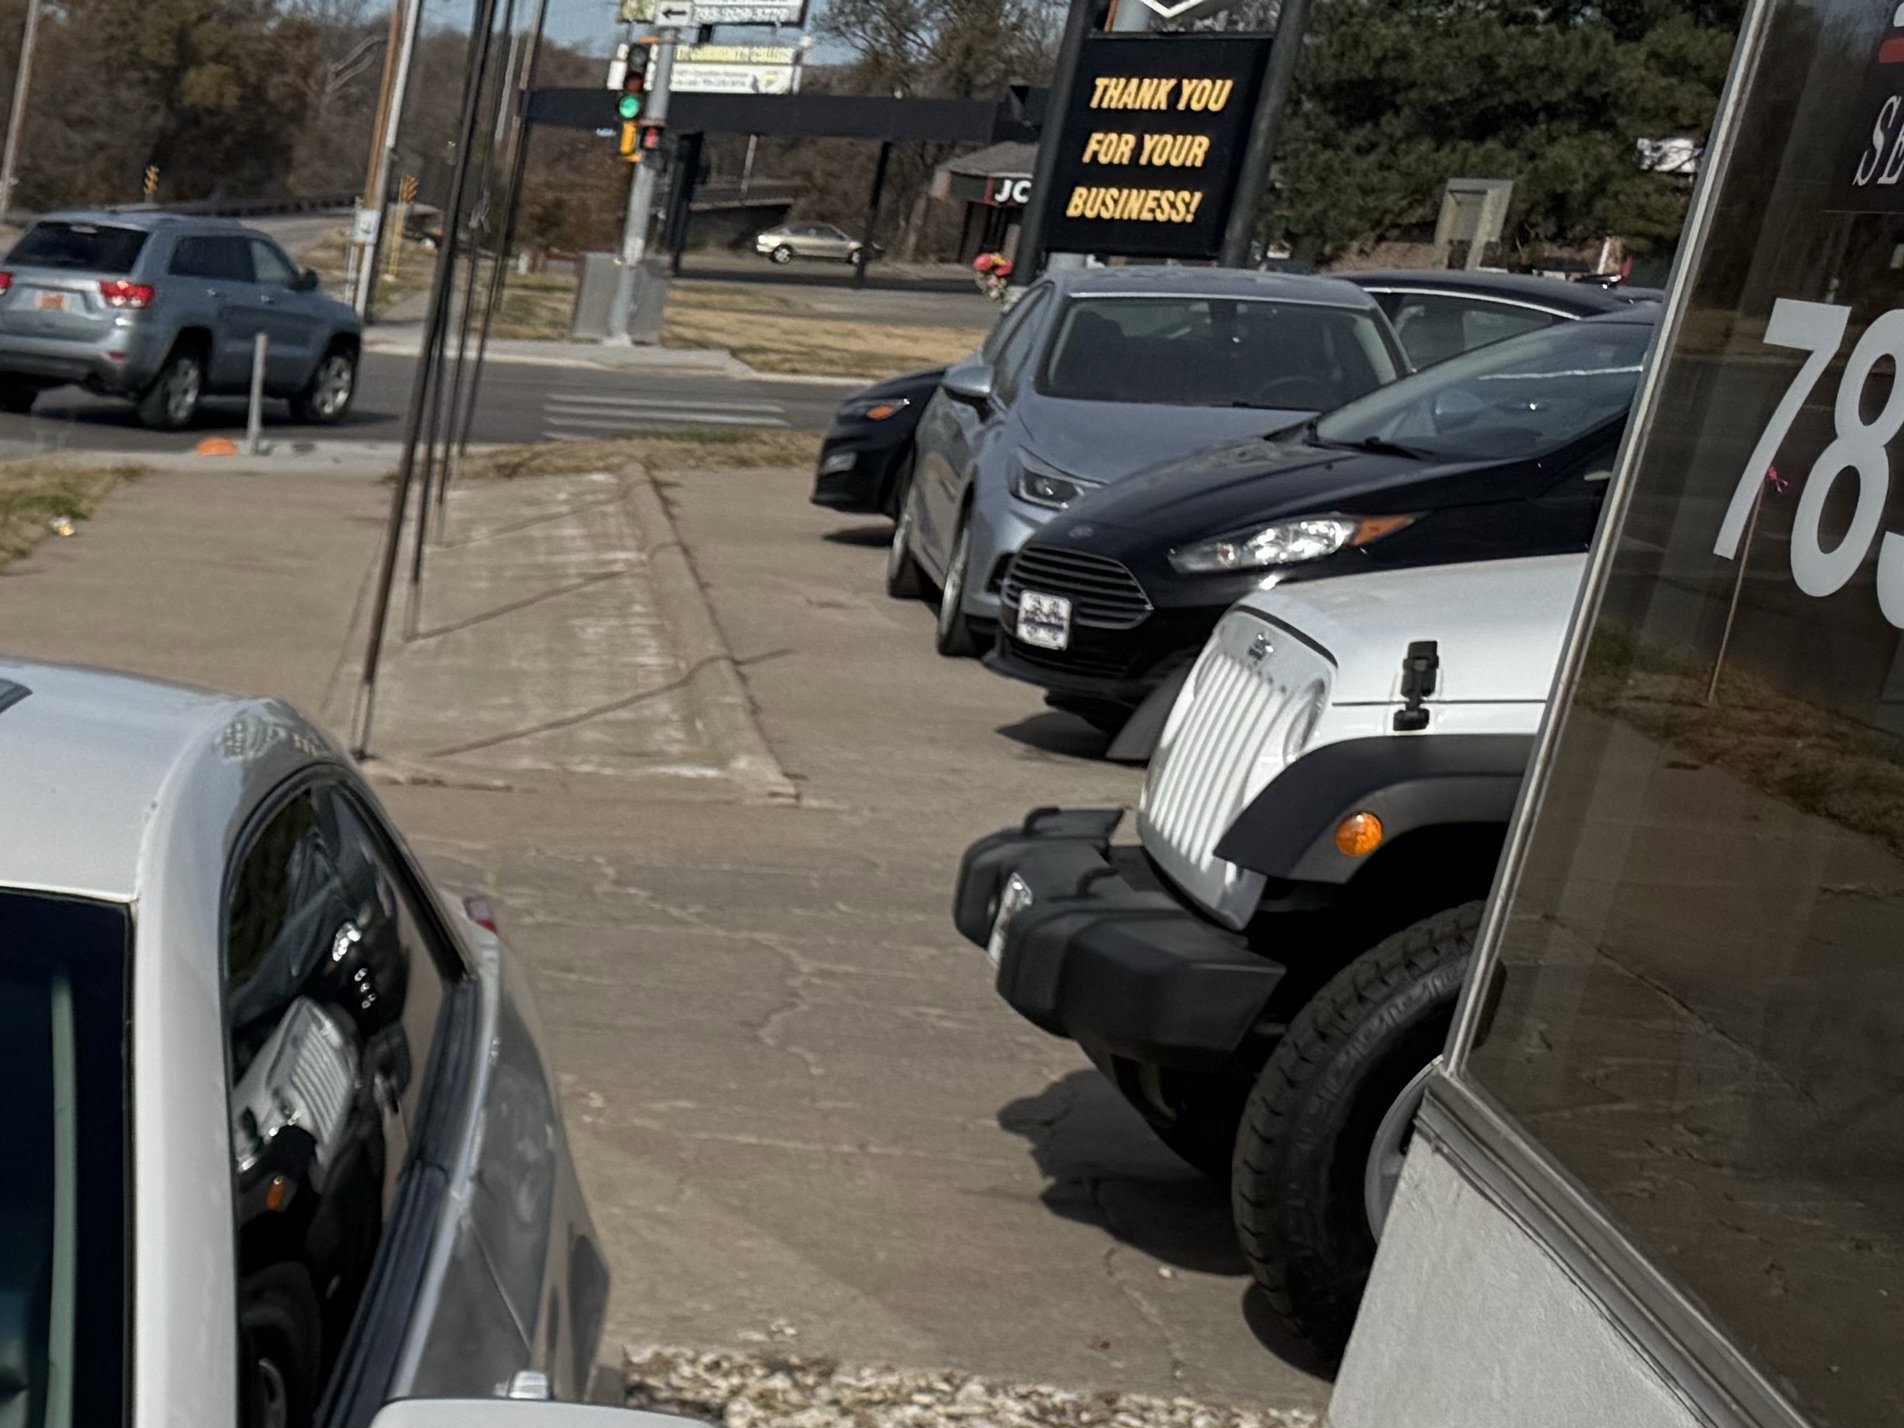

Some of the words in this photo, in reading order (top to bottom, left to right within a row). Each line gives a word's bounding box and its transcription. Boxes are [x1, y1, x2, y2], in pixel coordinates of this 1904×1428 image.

[1090, 77, 1177, 110] THANK
[1177, 79, 1234, 112] YOU
[1082, 132, 1137, 165] FOR
[1139, 134, 1210, 167] YOUR
[1065, 186, 1203, 223] BUSINESS!
